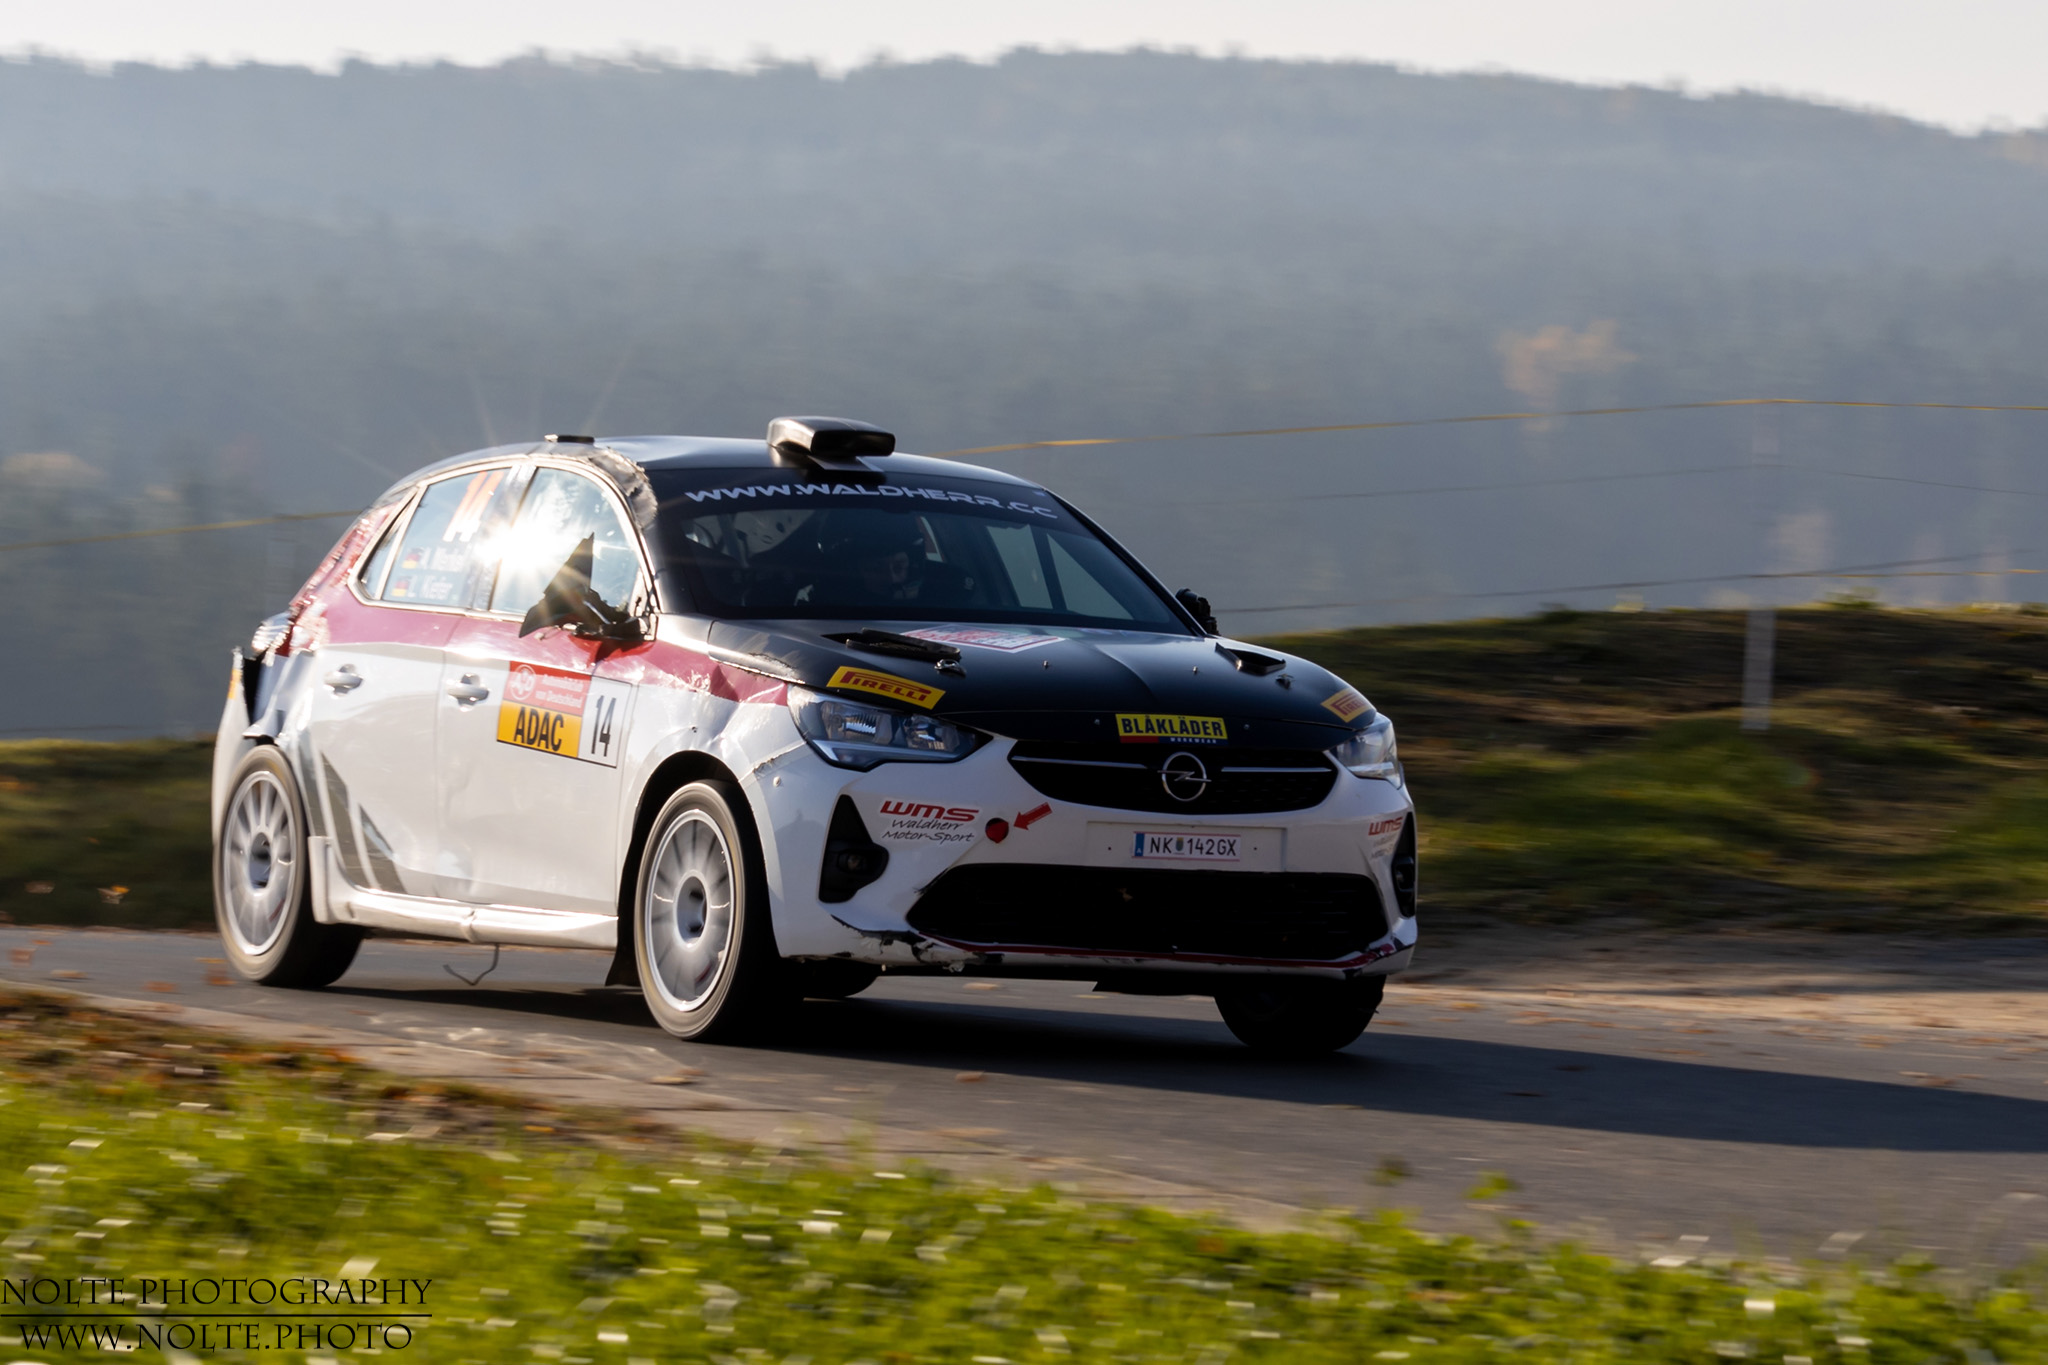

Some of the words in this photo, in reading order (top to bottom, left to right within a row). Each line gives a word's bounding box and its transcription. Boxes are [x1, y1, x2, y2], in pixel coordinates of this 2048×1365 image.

[684, 484, 1058, 519] WWW.WALDHERR.CC
[840, 671, 932, 702] PIRELLI
[514, 706, 564, 752] ADAC
[591, 695, 616, 757] 14
[1121, 714, 1224, 737] BLÅKLÄDER
[882, 831, 975, 845] Motor-Sport
[892, 819, 963, 831] Waldherr
[1150, 837, 1173, 854] NK
[1187, 838, 1237, 856] 142GX
